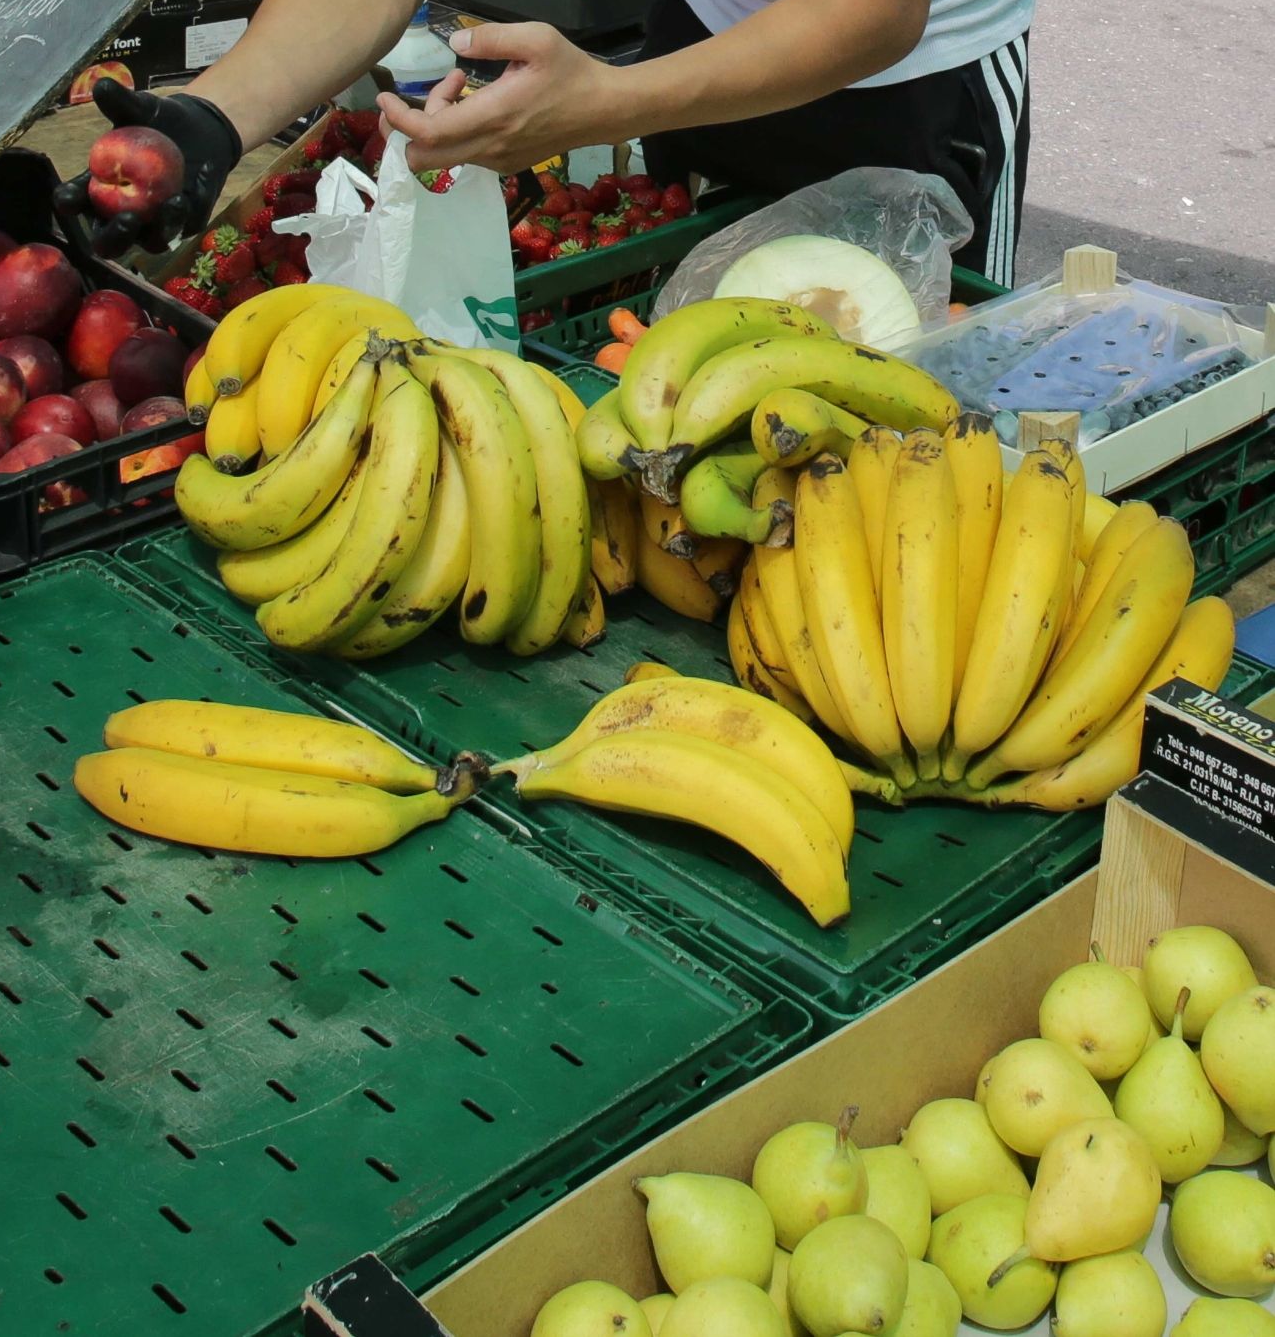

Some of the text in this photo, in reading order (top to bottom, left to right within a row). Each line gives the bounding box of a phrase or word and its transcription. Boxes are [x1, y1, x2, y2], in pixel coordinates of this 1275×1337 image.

[113, 36, 141, 50] font
[1184, 690, 1274, 740] Moreno
[1156, 745, 1181, 767] R.G.S.
[1239, 787, 1262, 809] R.I.A.
[1167, 734, 1188, 754] Tels.:
[1189, 745, 1206, 763] 948
[1205, 754, 1222, 770] 667
[1222, 762, 1238, 779] 236
[1244, 773, 1260, 790] 948
[1190, 779, 1211, 798] C.I.F.
[1222, 795, 1263, 825] 31566276
